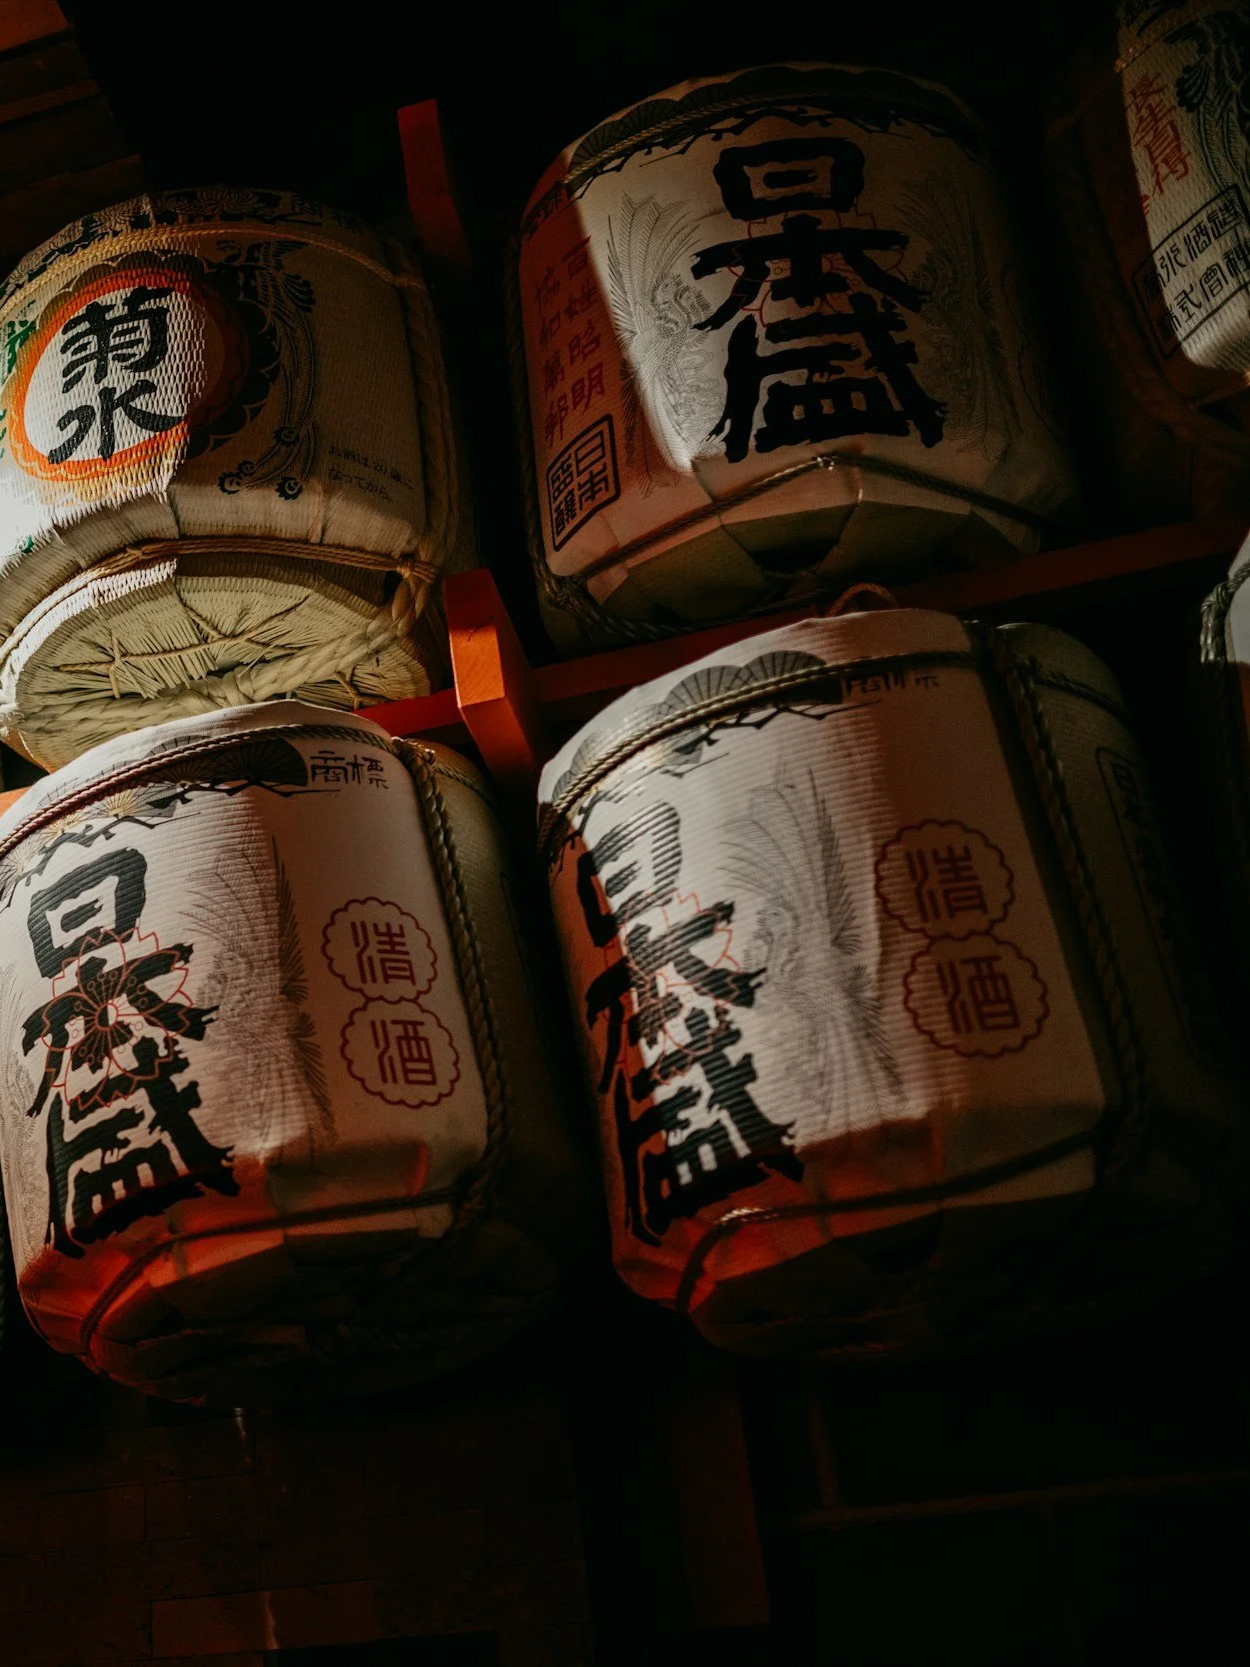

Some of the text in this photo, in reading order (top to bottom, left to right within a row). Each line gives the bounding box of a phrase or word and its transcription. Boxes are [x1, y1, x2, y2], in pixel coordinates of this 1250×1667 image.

[48, 284, 187, 465] 菊水
[690, 136, 950, 464] 日本盛
[21, 846, 241, 1259] 日本盛
